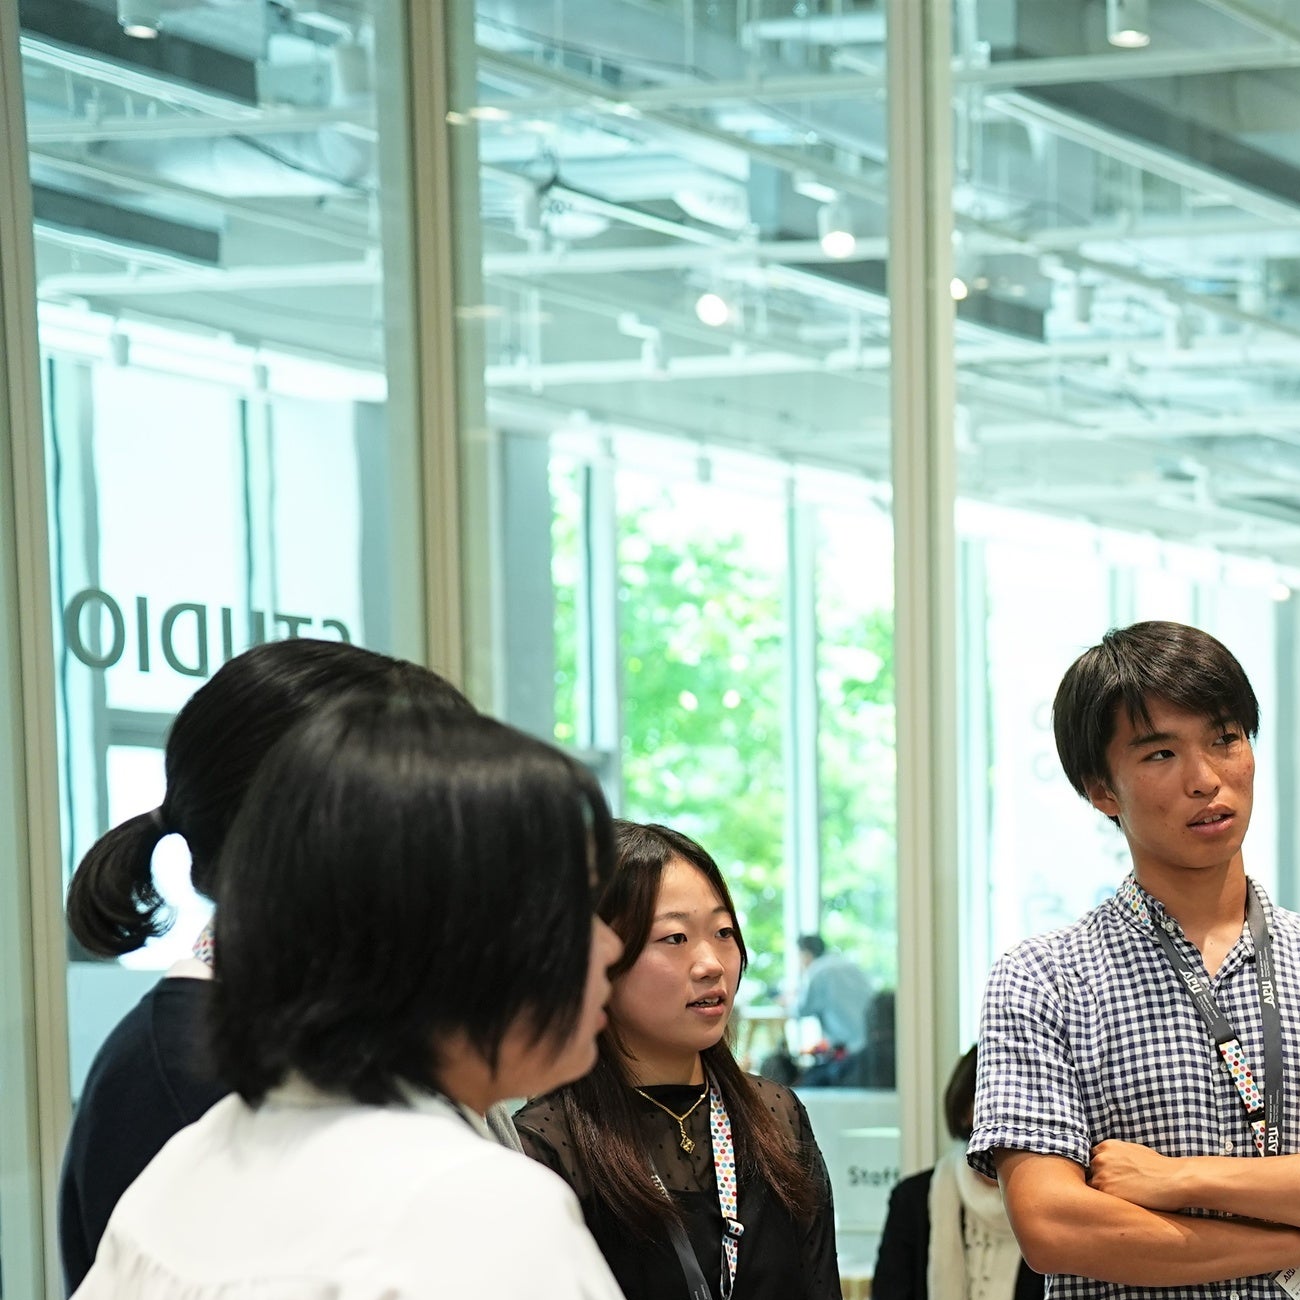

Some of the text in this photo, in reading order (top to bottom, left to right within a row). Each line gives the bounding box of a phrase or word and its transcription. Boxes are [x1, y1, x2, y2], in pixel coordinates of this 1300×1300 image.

[1179, 968, 1202, 995] APU
[1261, 979, 1276, 1009] APU
[1268, 1125, 1279, 1156] APU
